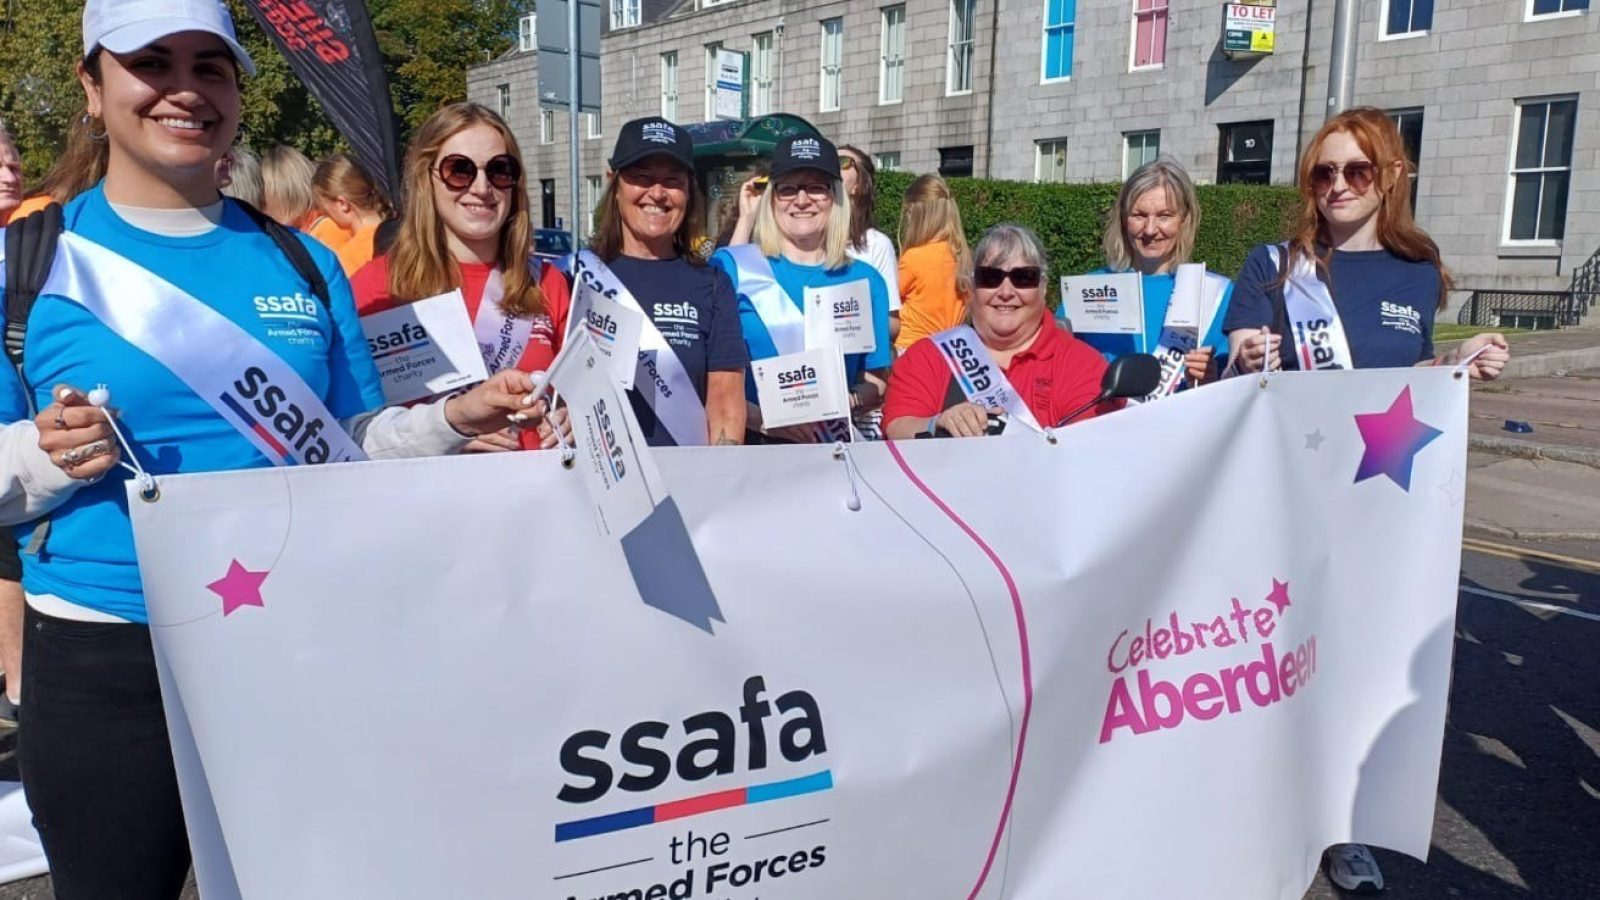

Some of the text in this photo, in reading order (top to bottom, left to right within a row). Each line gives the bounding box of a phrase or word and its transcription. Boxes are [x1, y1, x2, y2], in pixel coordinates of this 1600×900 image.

[1232, 5, 1274, 19] TO LET
[253, 292, 318, 316] ssafa
[833, 297, 860, 313] ssafa
[1082, 285, 1118, 299] ssafa
[587, 308, 617, 334] ssafa
[653, 301, 699, 320] ssafa
[1381, 301, 1420, 320] ssafa
[489, 335, 512, 374] Armed
[949, 337, 991, 392] ssafa
[643, 359, 673, 398] Forces
[778, 364, 817, 384] ssafa
[234, 366, 330, 465] ssafa
[596, 398, 626, 479] ssafa
[1107, 597, 1276, 673] Celebrate
[1099, 634, 1317, 744] Aberdeen
[556, 675, 827, 804] ssafa
[669, 831, 731, 864] the
[706, 846, 827, 894] Forces
